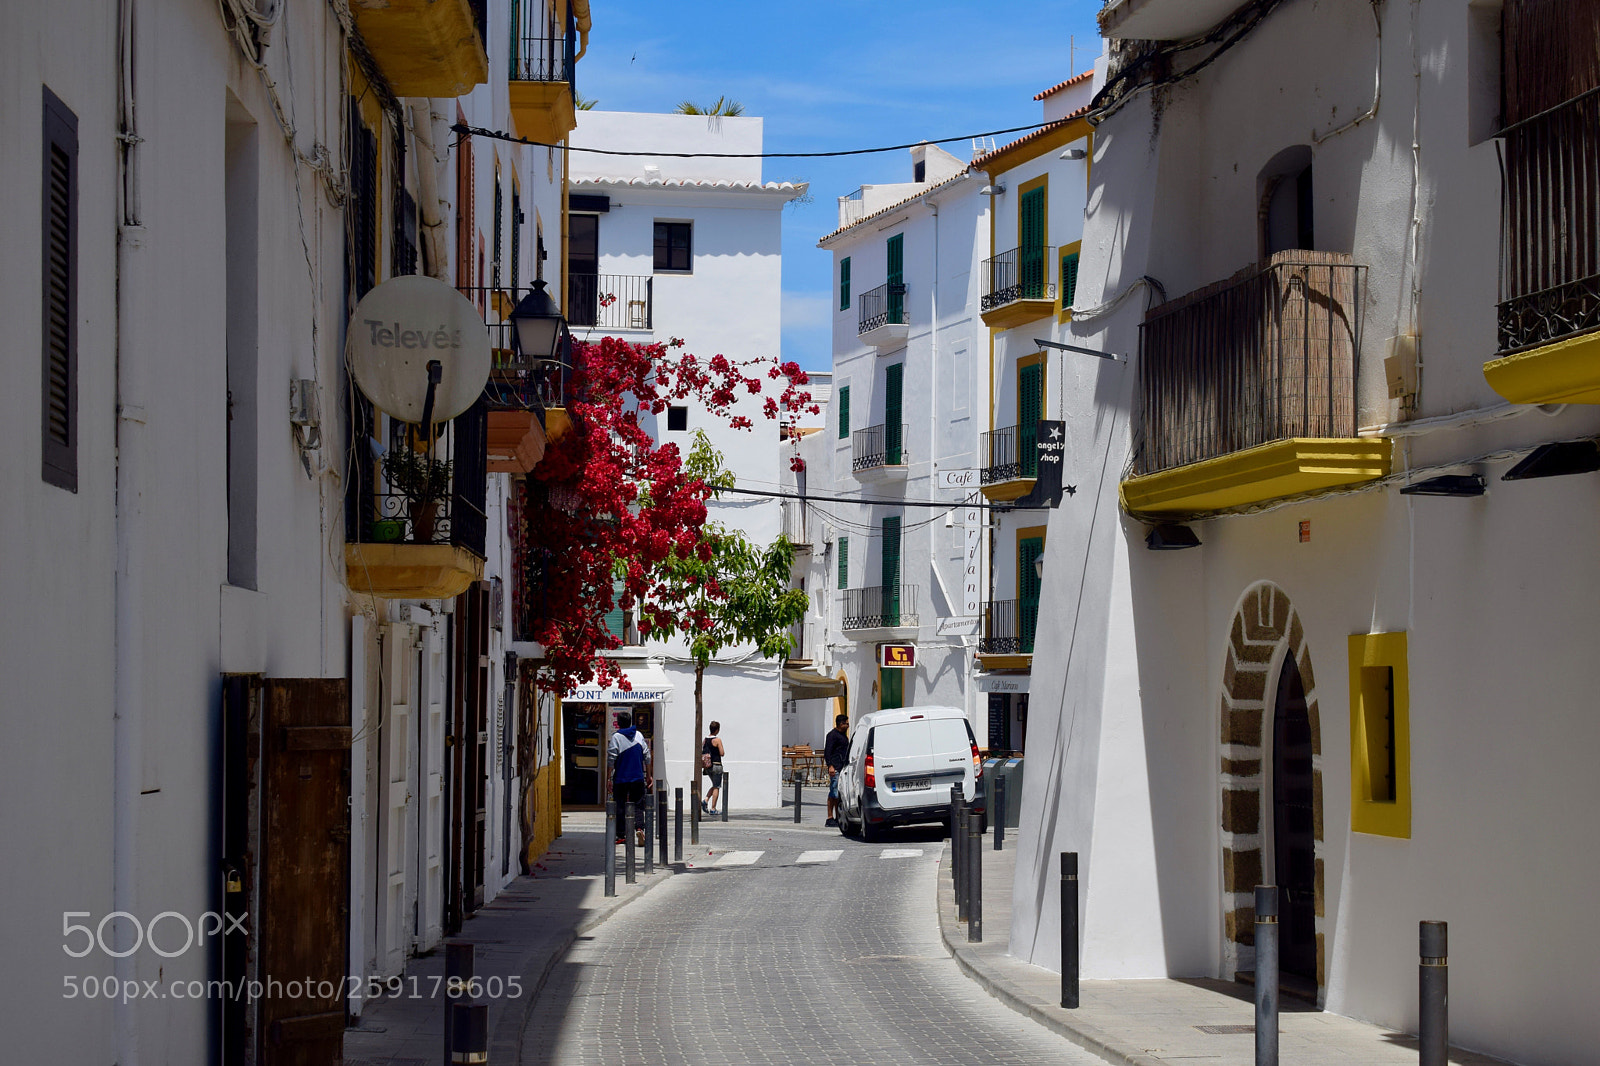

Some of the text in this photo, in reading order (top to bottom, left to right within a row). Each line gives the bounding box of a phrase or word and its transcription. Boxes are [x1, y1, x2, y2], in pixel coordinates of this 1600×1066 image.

[1040, 453, 1060, 464] shop
[946, 471, 973, 486] Café
[966, 491, 979, 611] Mariano
[611, 691, 665, 700] MINIMARKET
